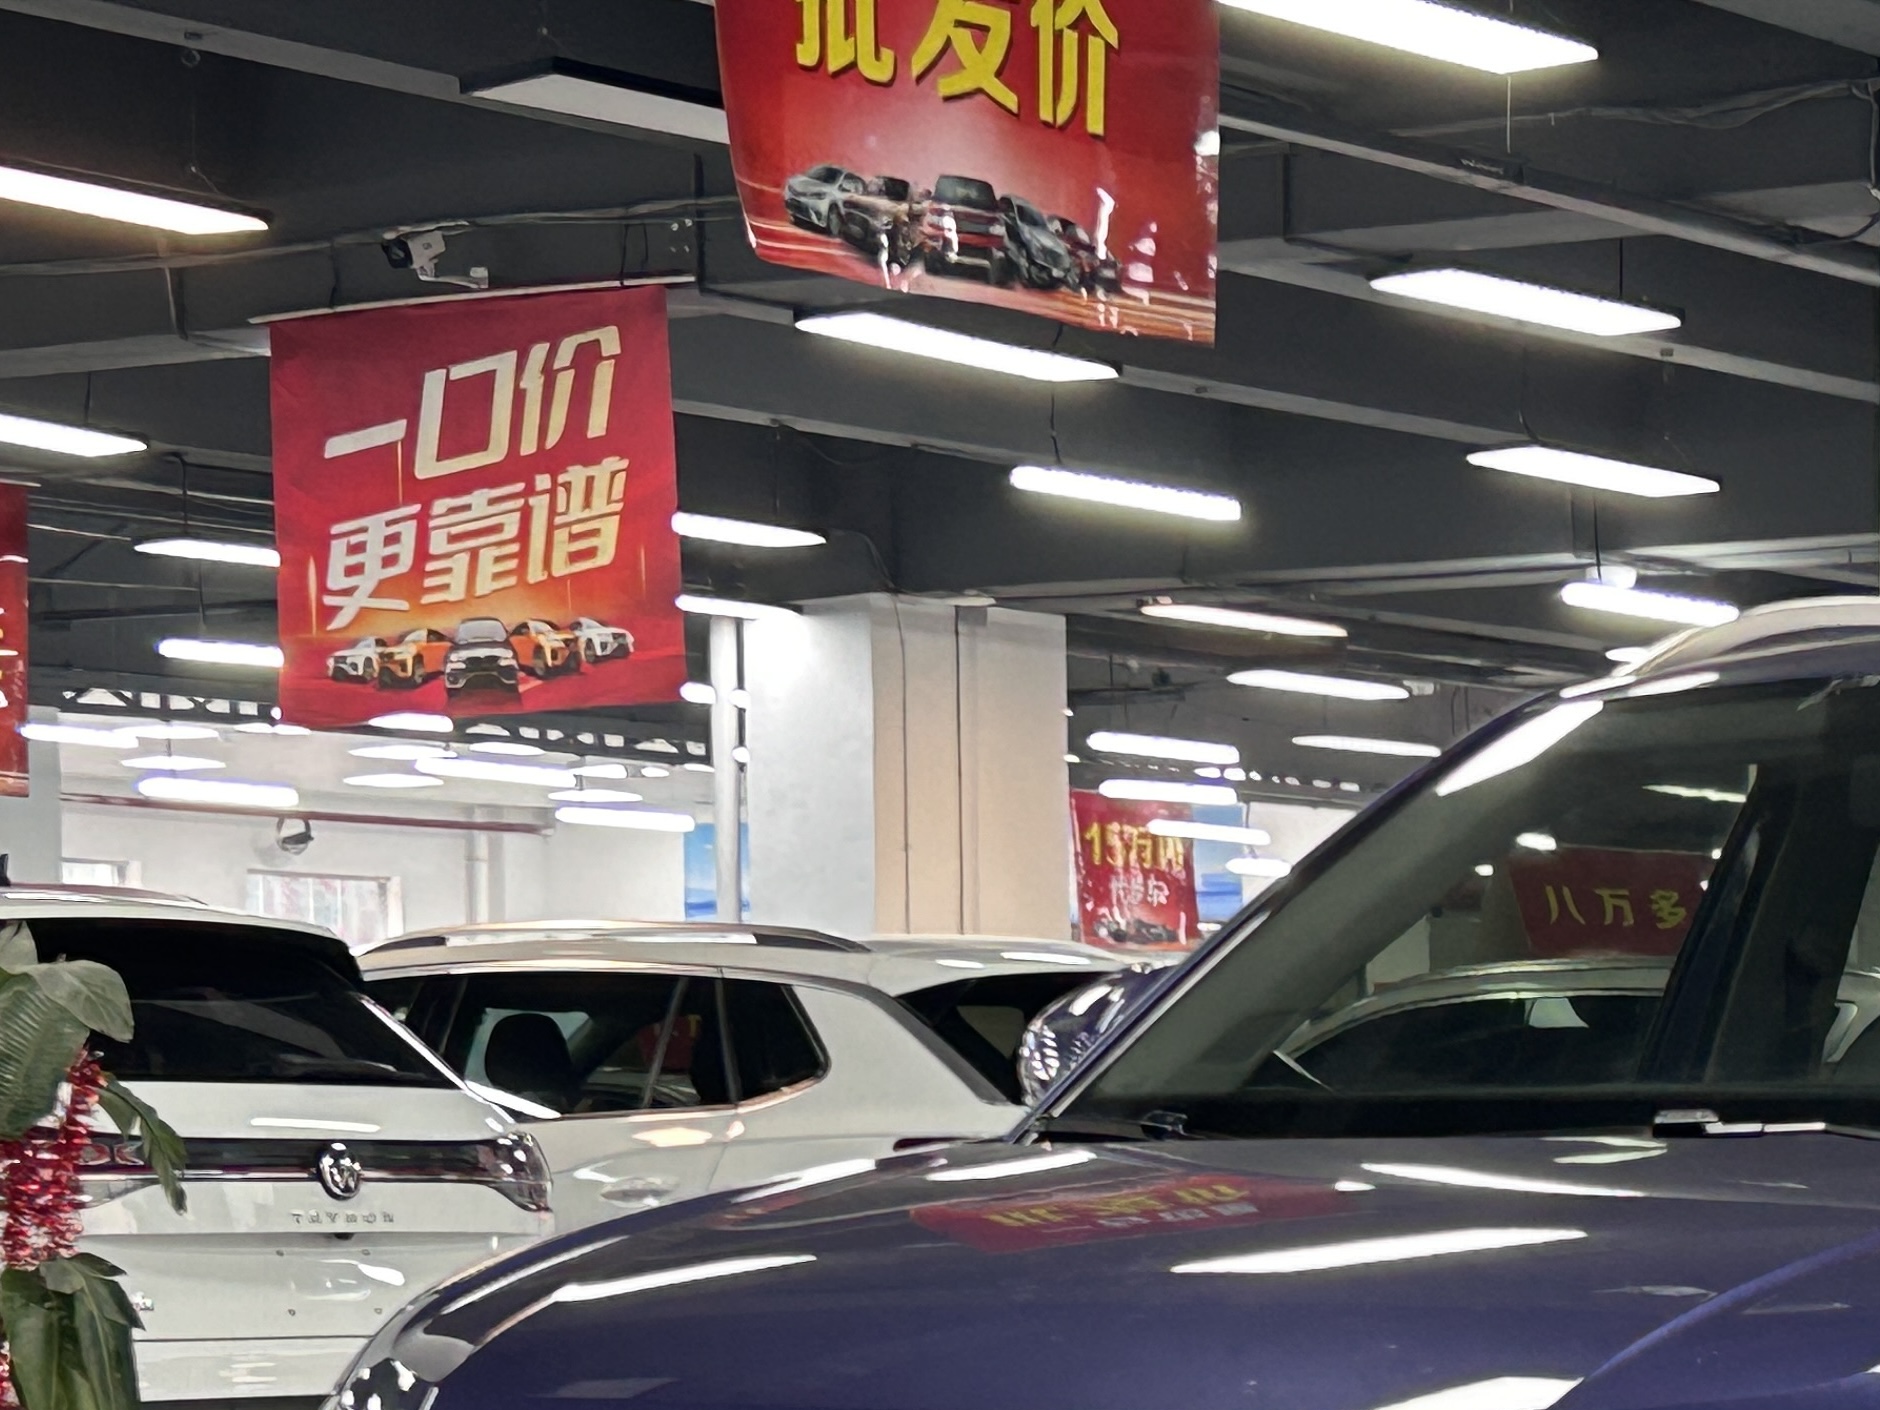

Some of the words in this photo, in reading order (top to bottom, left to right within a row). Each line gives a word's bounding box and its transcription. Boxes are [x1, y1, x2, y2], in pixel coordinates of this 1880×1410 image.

[324, 326, 622, 480] 一口价
[322, 456, 630, 630] 更靠谱
[1544, 884, 1687, 929] 八万多
